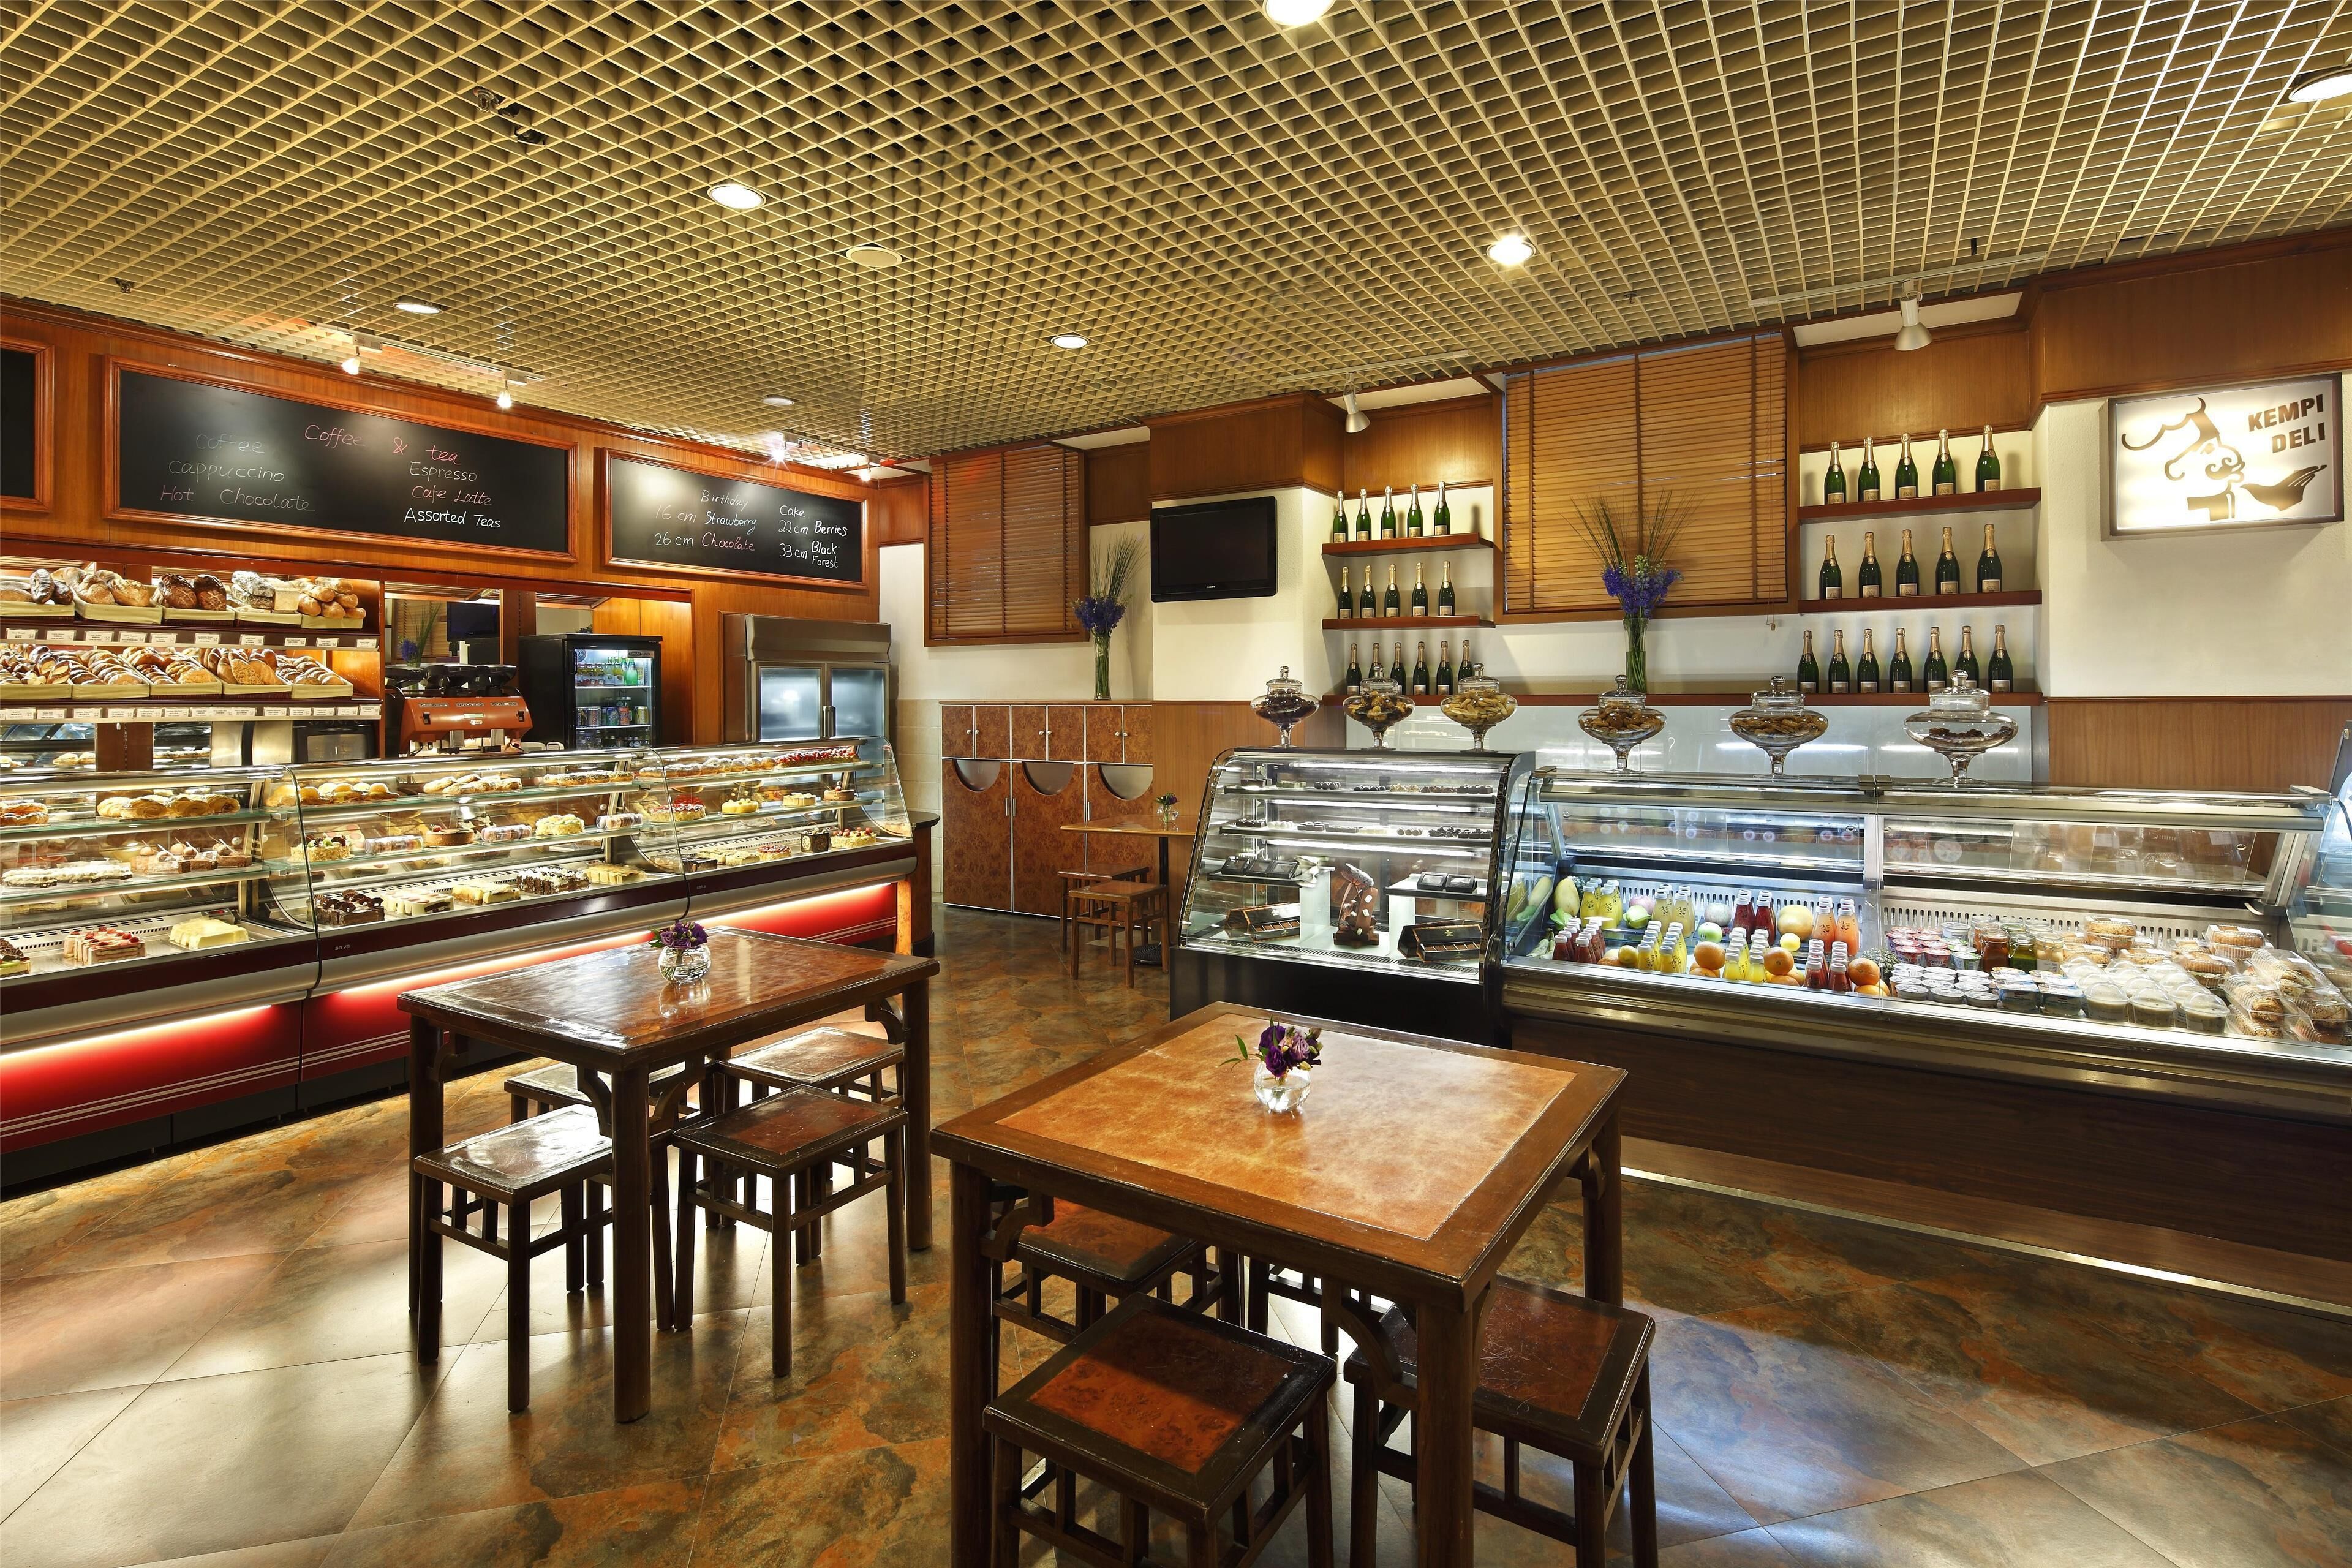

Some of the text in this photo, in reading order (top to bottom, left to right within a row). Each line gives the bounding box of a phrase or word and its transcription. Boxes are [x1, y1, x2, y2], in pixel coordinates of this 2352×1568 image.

[2248, 394, 2323, 432] KEMPI
[304, 424, 461, 465] Coffee & tea
[2272, 422, 2326, 454] DELI
[410, 461, 477, 481] Espresso
[160, 484, 315, 512] Hot Chocolate
[412, 484, 492, 505] Cafe Latte
[701, 489, 805, 518] Birthday Cake
[404, 507, 500, 529] Assorted Teas
[655, 504, 757, 535] 16 cm Strawberry
[814, 521, 848, 537] Berries
[654, 533, 755, 551] 26 cm Chocolate
[812, 540, 837, 555] Black
[812, 556, 839, 568] Forest
